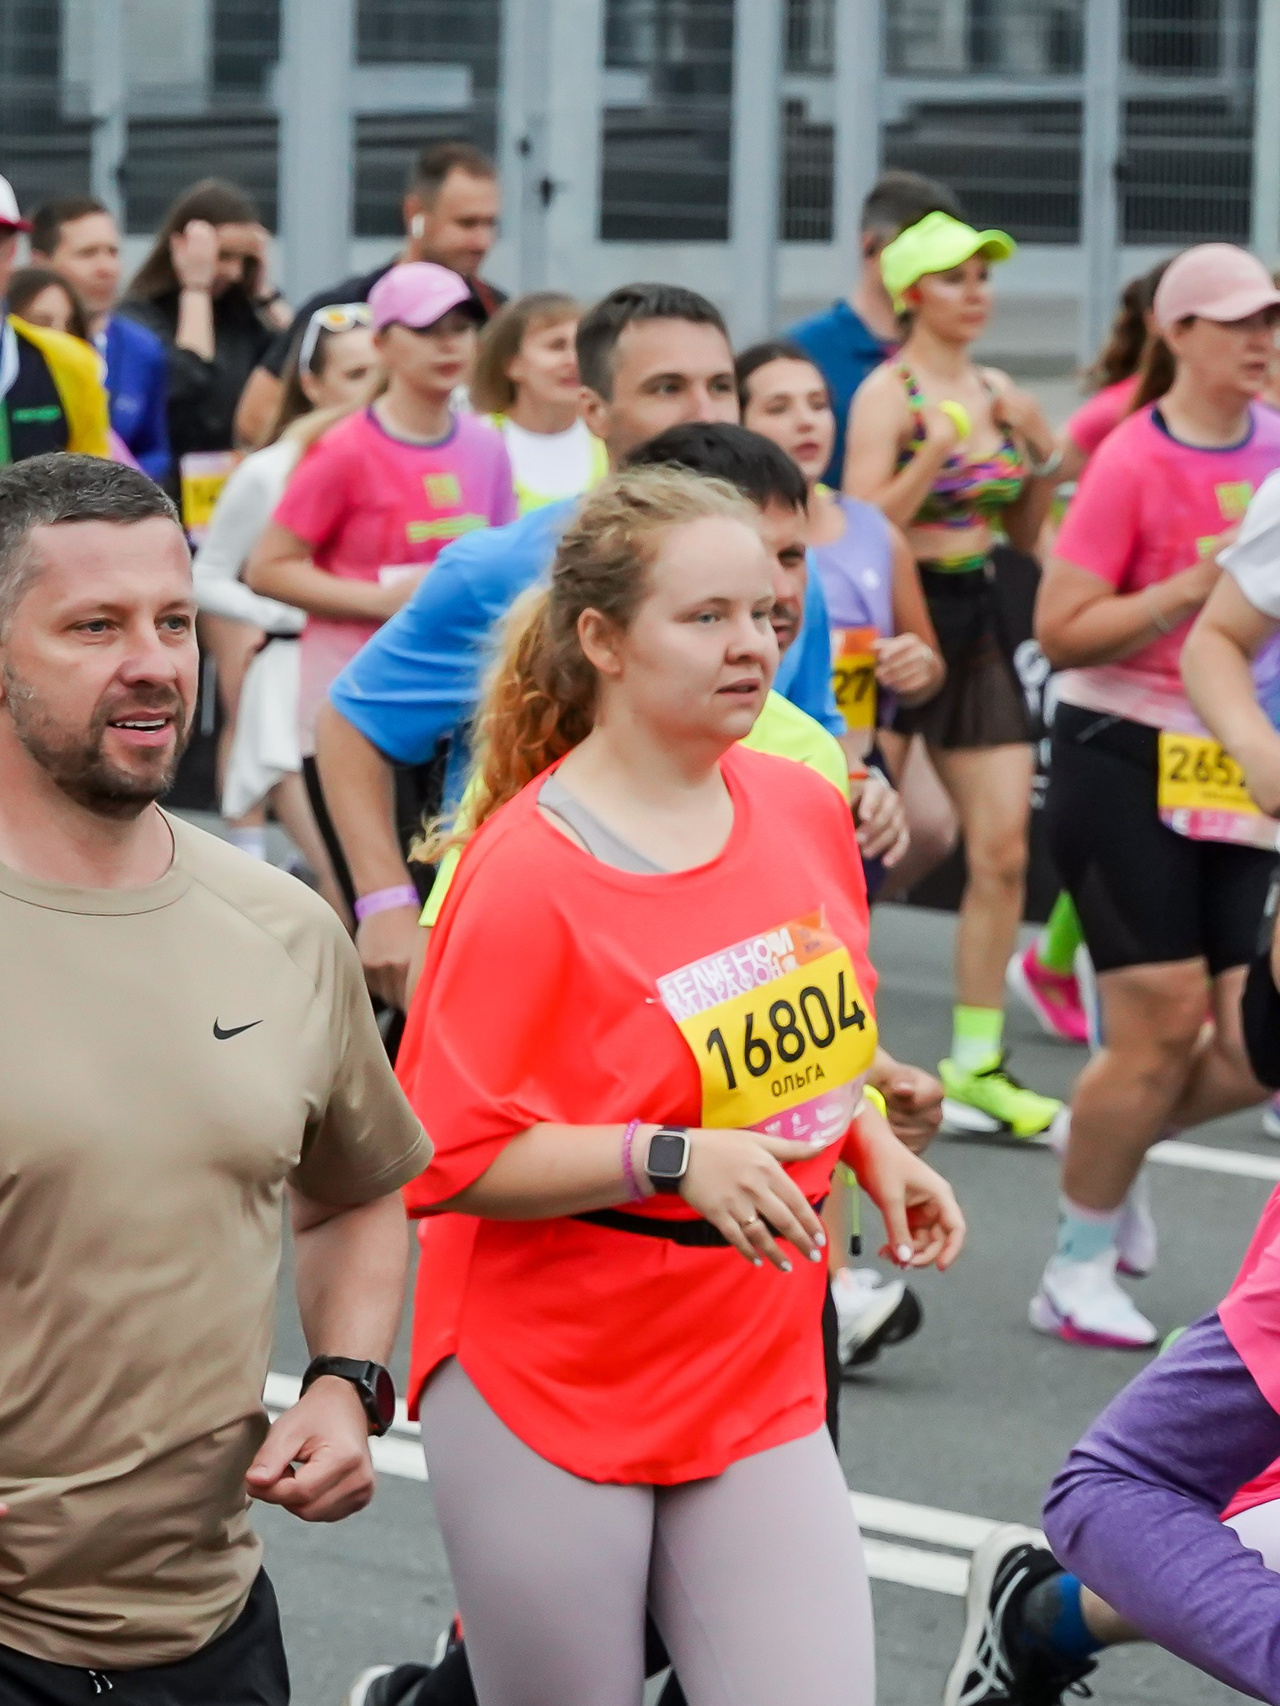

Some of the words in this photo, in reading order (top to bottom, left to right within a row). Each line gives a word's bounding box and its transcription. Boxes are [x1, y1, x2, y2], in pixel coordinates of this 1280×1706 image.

[1169, 746, 1246, 788] 265
[706, 970, 866, 1091] 16804
[771, 1063, 826, 1098] ОЛЬГА
